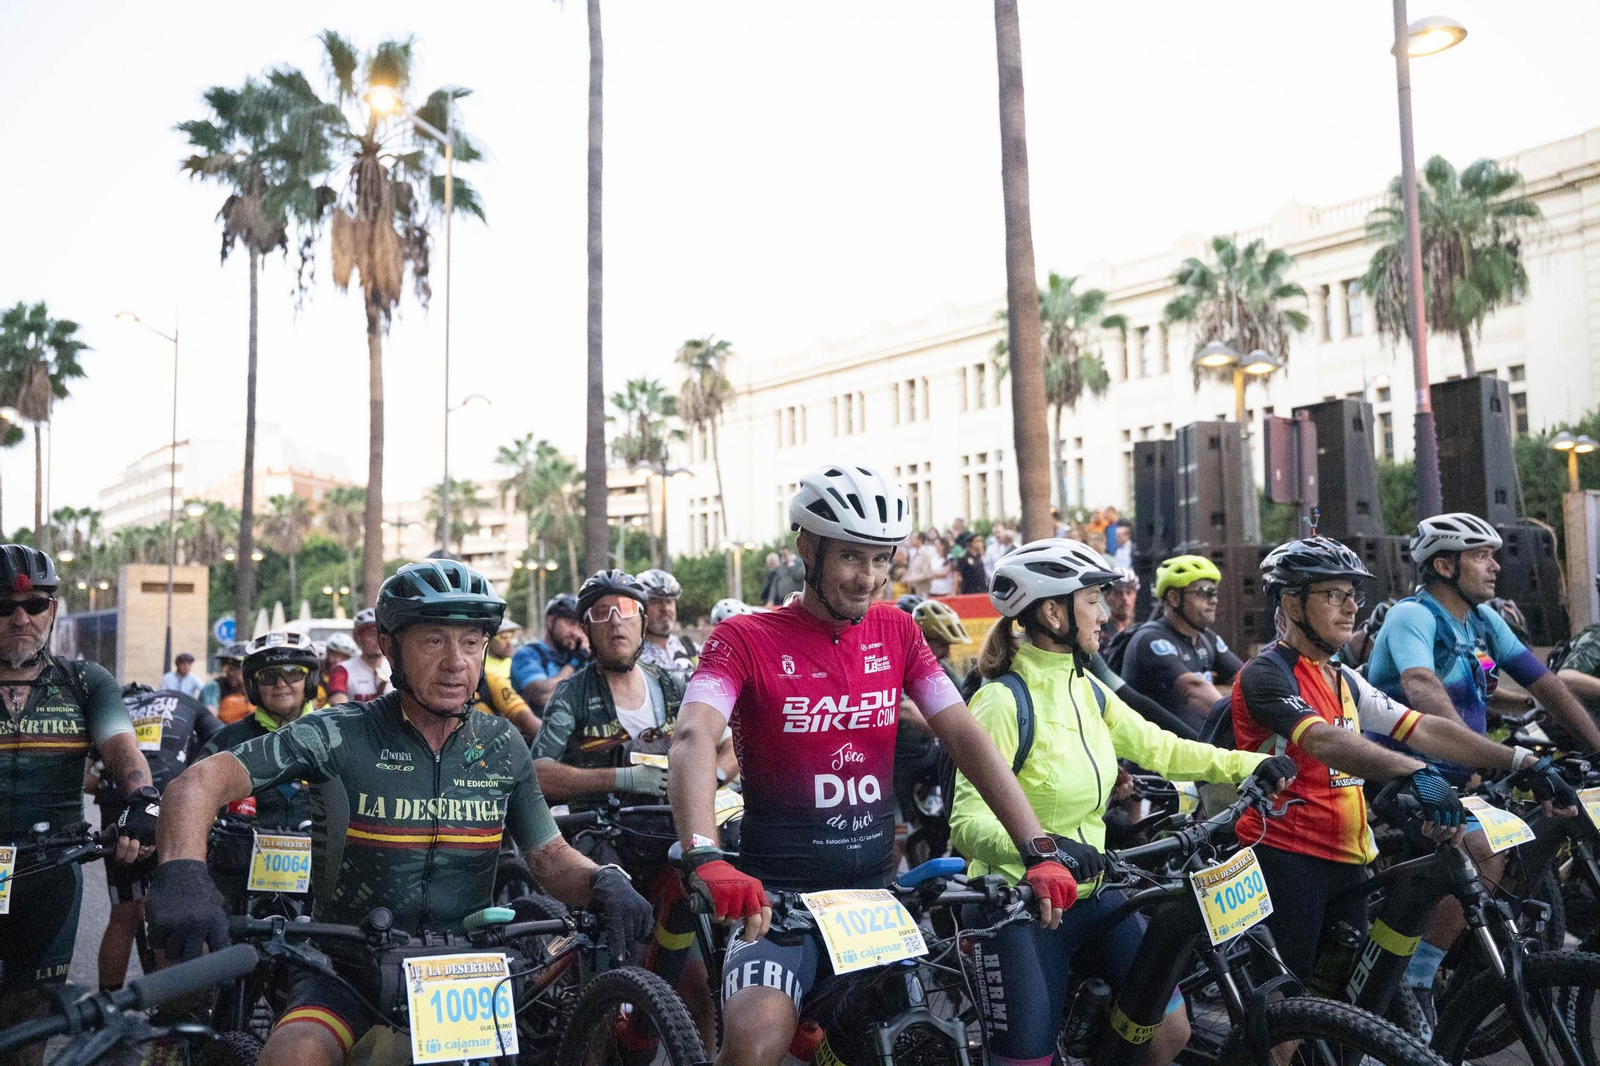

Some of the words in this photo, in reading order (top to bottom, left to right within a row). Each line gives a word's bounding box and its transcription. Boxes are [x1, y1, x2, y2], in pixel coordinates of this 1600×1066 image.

[782, 687, 897, 714] BALDU
[453, 779, 466, 787] VII
[467, 777, 499, 788] EDICIÓN
[357, 792, 387, 819] LA
[394, 792, 500, 822] DESÉRTICA
[826, 814, 848, 830] de
[852, 811, 874, 831] bici
[265, 853, 309, 873] 10064
[1214, 870, 1263, 914] 10030
[835, 905, 906, 937] 10227
[1231, 908, 1259, 929] cajamar
[860, 942, 902, 958] cajamar
[428, 964, 442, 976] LA
[983, 953, 1008, 1031] HERMI
[430, 985, 510, 1024] 10096
[480, 1023, 513, 1031] GUILLRMO
[445, 1037, 492, 1053] cajamar
